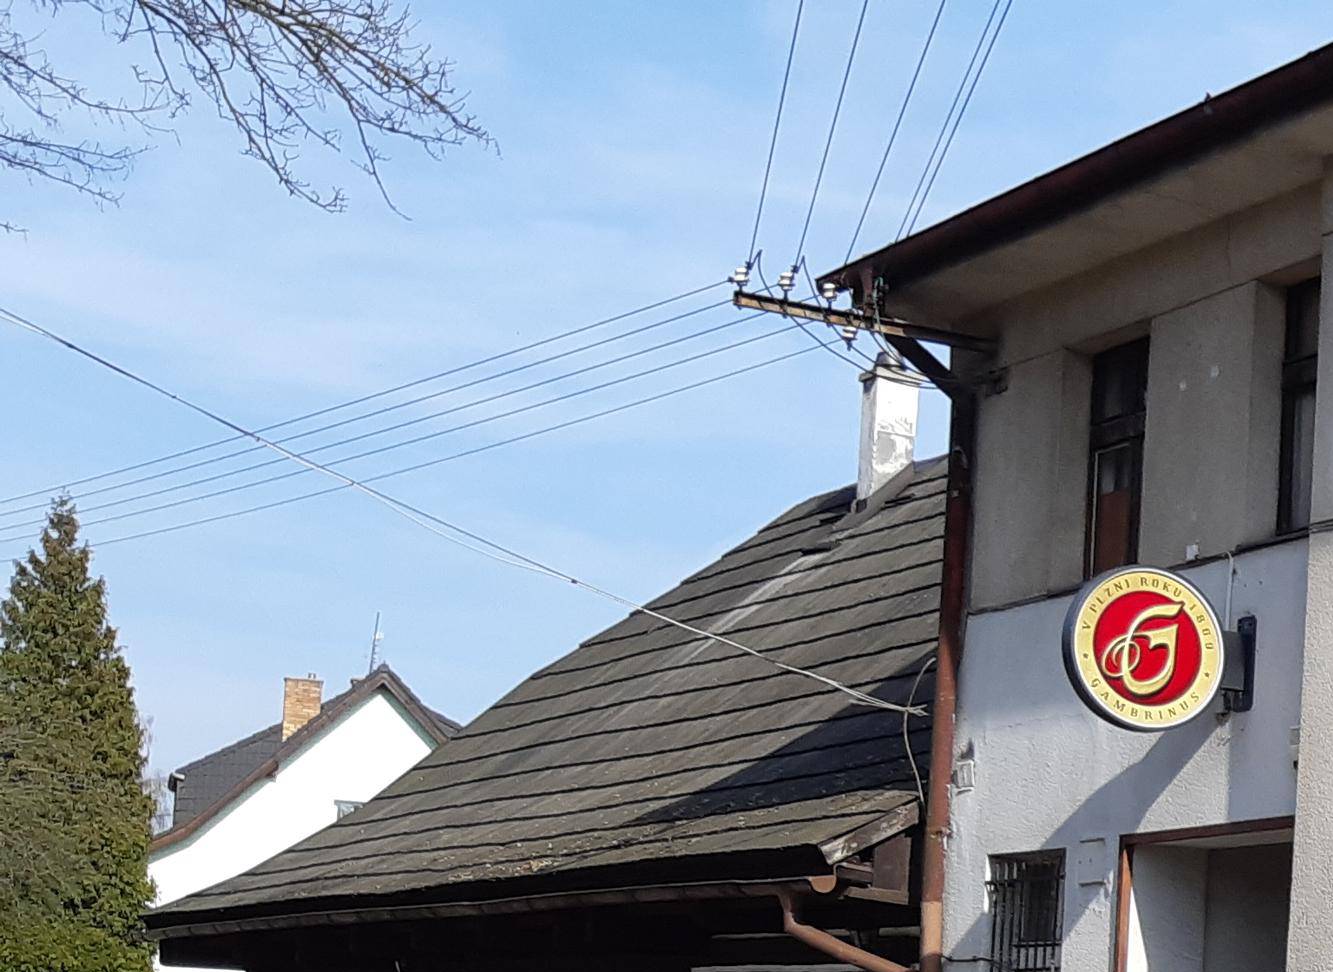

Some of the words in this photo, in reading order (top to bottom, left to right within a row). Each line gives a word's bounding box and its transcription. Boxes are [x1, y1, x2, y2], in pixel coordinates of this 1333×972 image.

[1081, 622, 1092, 632] V
[1090, 578, 1131, 614] PLZNI
[1139, 576, 1182, 599] ROKU
[1090, 677, 1201, 721] GAMBRINUS
